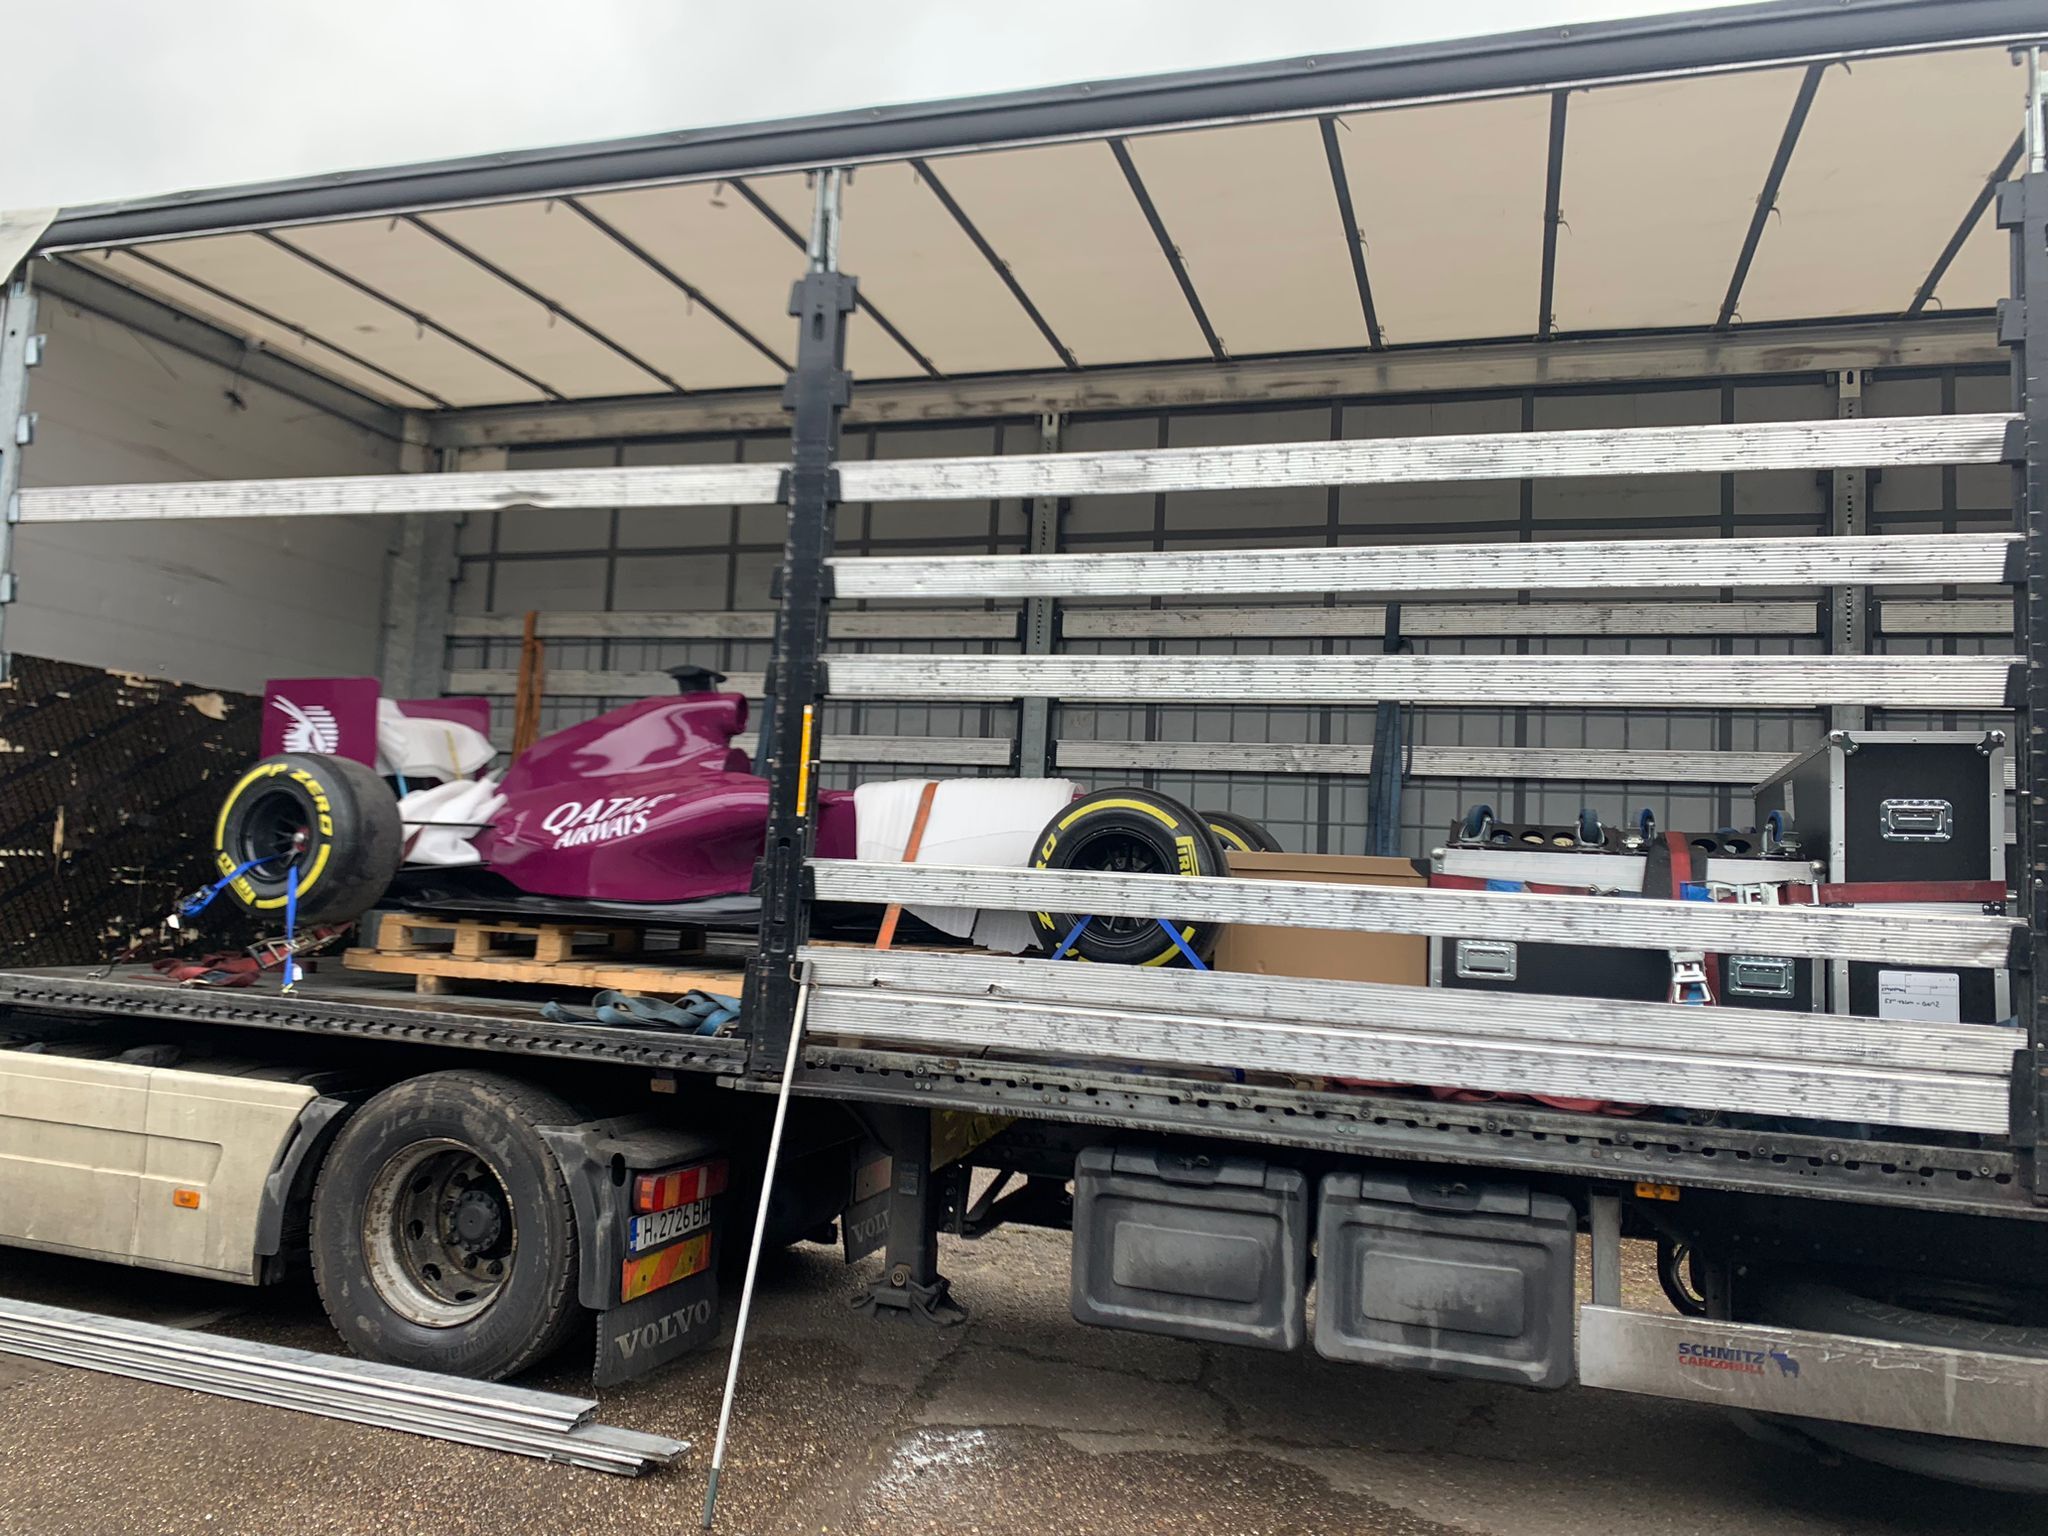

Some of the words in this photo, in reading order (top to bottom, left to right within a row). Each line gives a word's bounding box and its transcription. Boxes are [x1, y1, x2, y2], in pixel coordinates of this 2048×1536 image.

[272, 763, 288, 777] P
[289, 768, 334, 837] ZERO
[541, 793, 677, 836] QATAR
[552, 809, 651, 850] AIRWAYS
[614, 1299, 711, 1360] VOLVO
[1678, 1343, 1766, 1364] SCHMITZ
[1678, 1355, 1766, 1376] CARGOBULL
